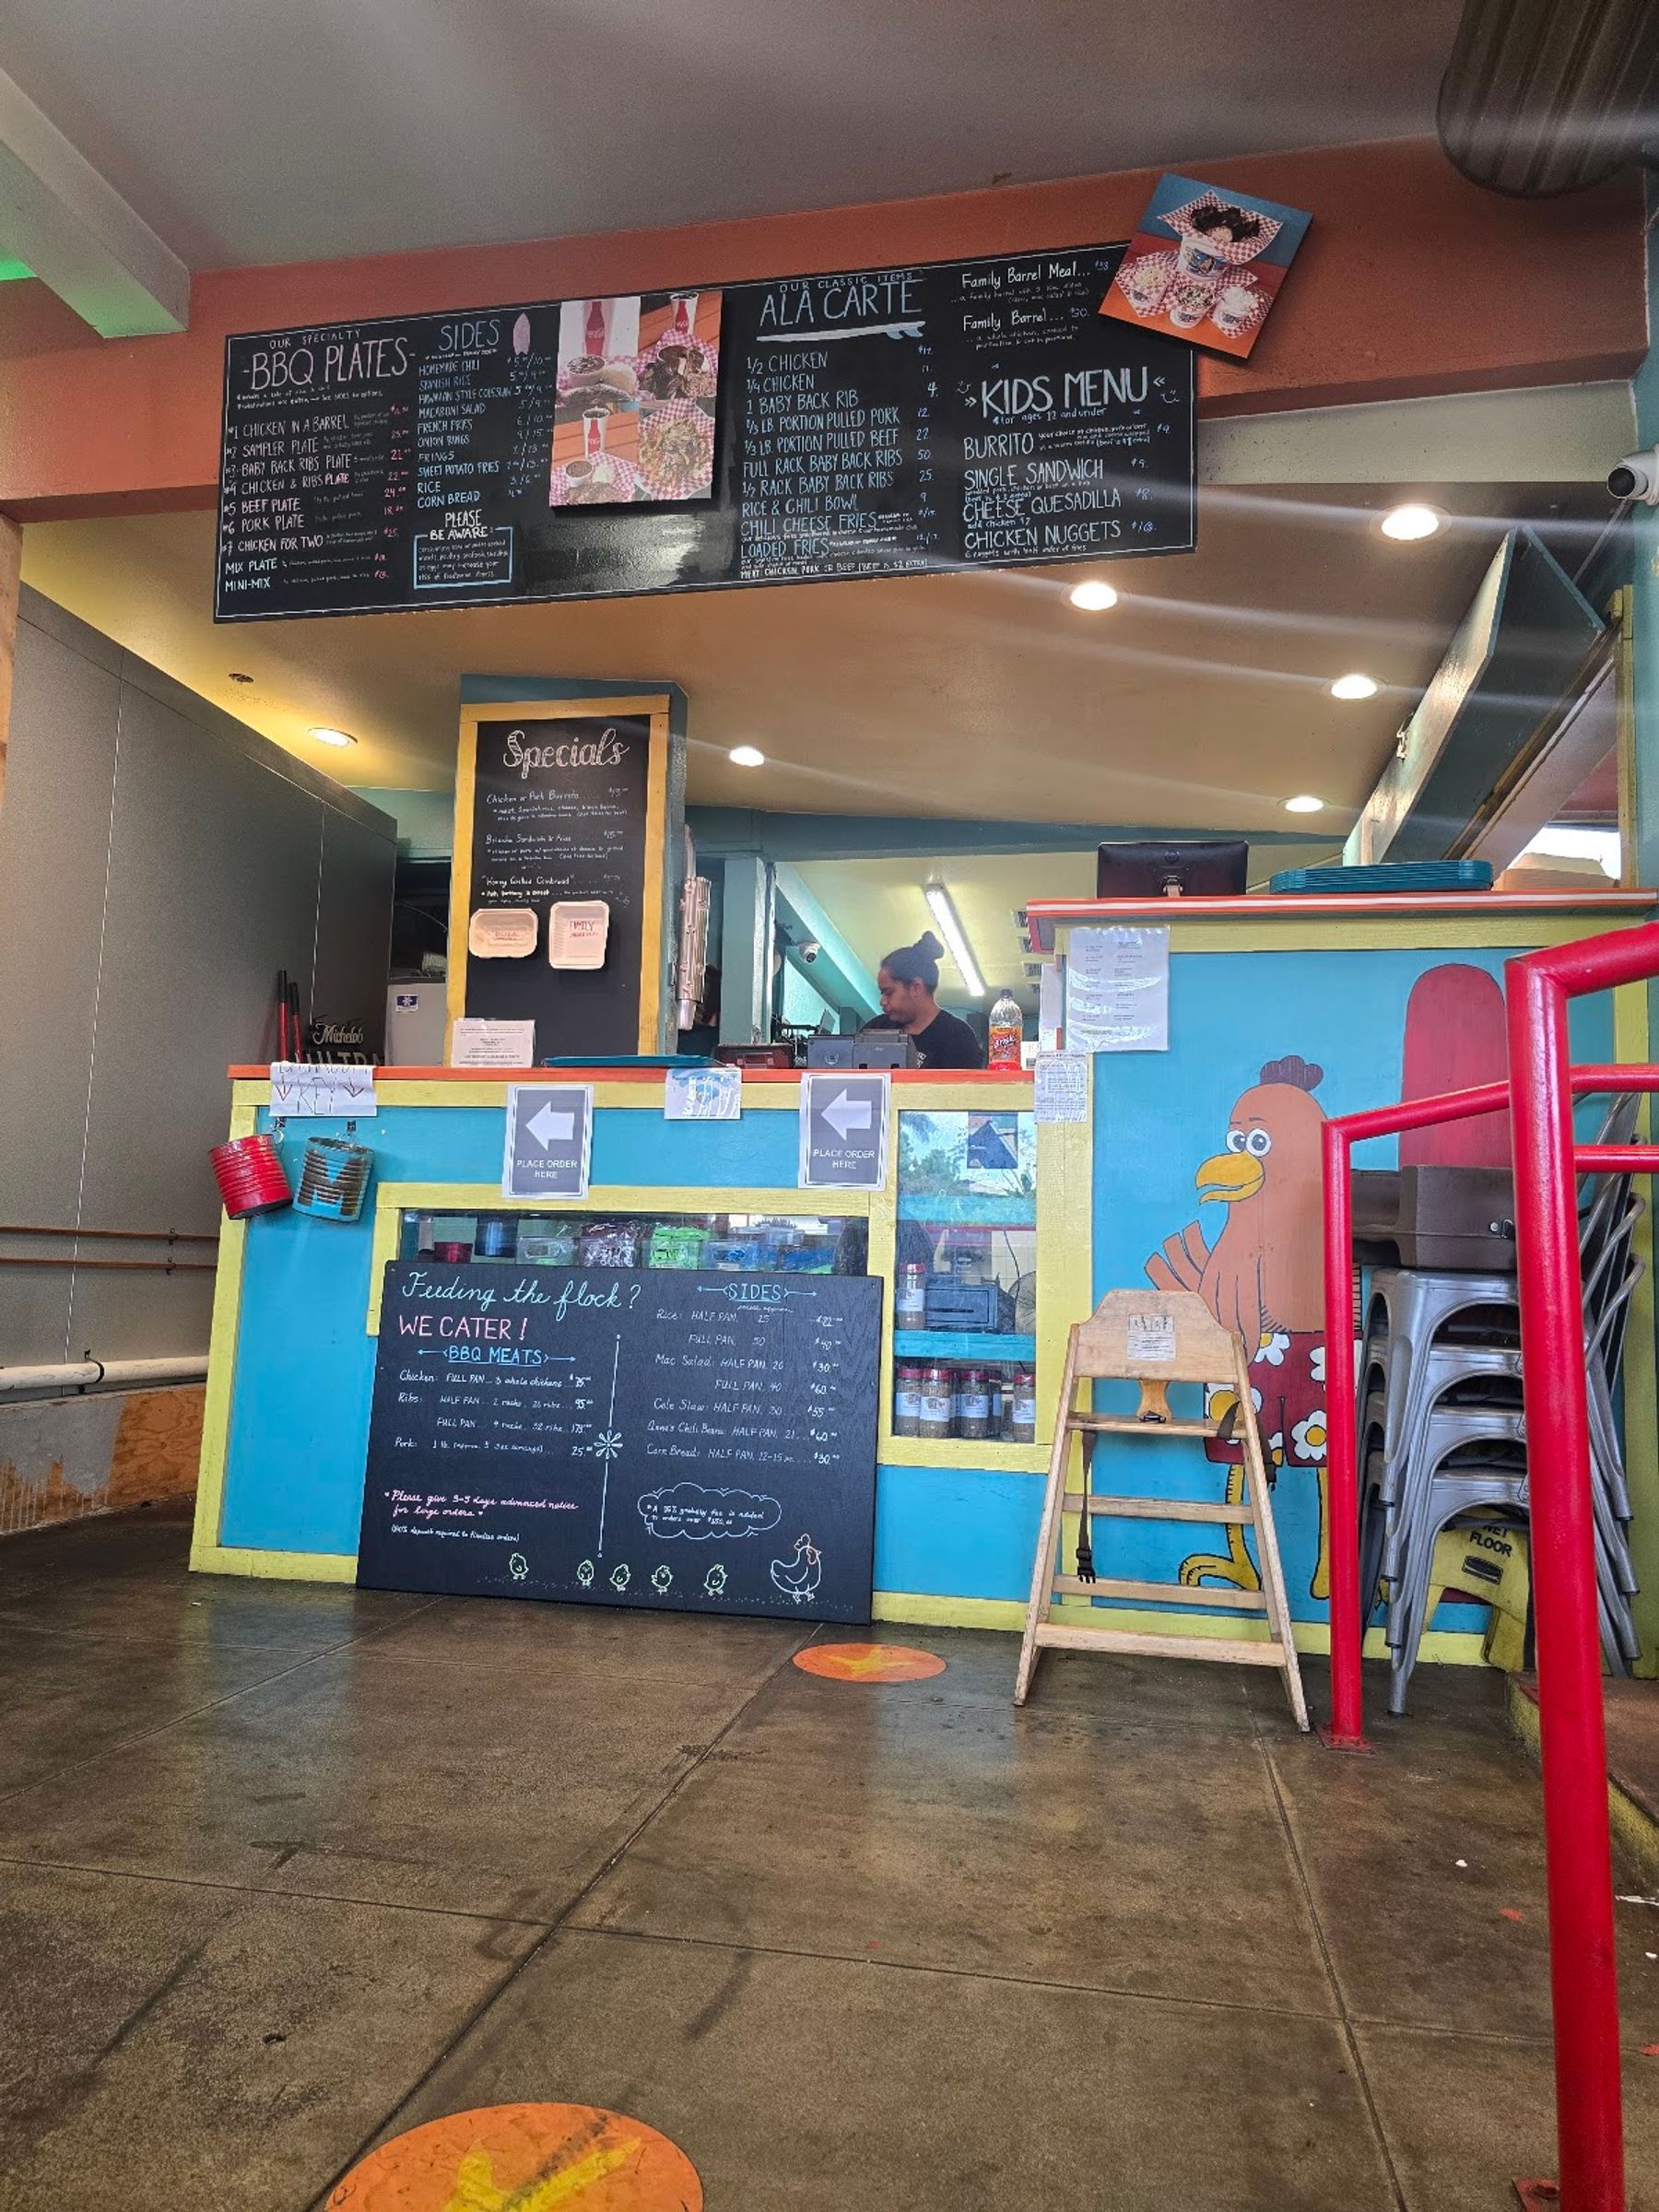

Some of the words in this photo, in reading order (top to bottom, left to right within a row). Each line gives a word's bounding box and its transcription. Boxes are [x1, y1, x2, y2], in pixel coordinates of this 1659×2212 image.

[780, 281, 810, 292] OUR
[818, 276, 867, 289] CLASSIC
[877, 272, 912, 283] ITEMS
[962, 270, 1001, 289] Family
[1007, 264, 1041, 283] Barrel
[823, 279, 924, 319] CARTE
[963, 312, 1001, 331] Family
[269, 337, 291, 349] OUR
[301, 329, 361, 346] SPECIALTY
[438, 319, 500, 351] SIDES
[769, 351, 828, 372] CHICKEN
[763, 373, 815, 393] CHICKEN
[982, 376, 1053, 418] KIDS
[1065, 367, 1147, 409] MENU
[759, 395, 792, 415] BABY
[797, 392, 830, 411] BACK
[836, 389, 859, 409] RIB
[302, 419, 310, 432] A
[312, 414, 349, 432] BARREL
[780, 414, 824, 432] PORTION
[827, 409, 865, 429] PULLED
[870, 406, 901, 427] PORK
[1021, 414, 1041, 424] ages
[1046, 411, 1057, 421] 12
[242, 441, 285, 458] SAMPLER
[291, 438, 319, 455] PLATE
[777, 434, 823, 453] PORTION
[827, 431, 865, 450] PULLED
[870, 428, 900, 448] BEEF
[964, 432, 1034, 461] BURRITO
[241, 463, 265, 477] BABY
[271, 459, 295, 475] BACK
[299, 456, 319, 472] RIBS
[326, 453, 352, 469] PLATE
[743, 461, 769, 477] FULL
[775, 456, 806, 476] RACK
[809, 453, 839, 473] BABY
[841, 451, 872, 470] BACK
[876, 449, 902, 467] RIBS
[241, 479, 285, 495] CHICKEN
[302, 475, 323, 488] RIBS
[324, 473, 349, 486] PLATE
[760, 477, 793, 497] RACK
[799, 475, 830, 495] BABY
[835, 473, 865, 491] BACK
[868, 471, 894, 488] RIBS
[964, 465, 1018, 490] SINGLE
[1026, 458, 1103, 485] SANDWICH
[418, 481, 441, 494] RICE
[241, 499, 269, 514] BEEF
[271, 498, 301, 512] PLATE
[418, 496, 444, 509] CORN
[448, 490, 480, 504] BREAD
[742, 500, 767, 518] RICE
[771, 500, 781, 517] &
[785, 498, 818, 514] CHILI
[825, 493, 859, 512] BOWL
[962, 499, 1026, 523] CHEESE
[1030, 488, 1122, 515] QUESADILLA
[241, 519, 270, 533] PORK
[276, 513, 305, 530] PLATE
[444, 509, 483, 528] PLEASE
[741, 517, 776, 536] CHILI
[783, 515, 832, 535] CHEESE
[839, 512, 877, 529] FRIES
[238, 540, 276, 552] CHICKEN
[280, 537, 299, 550] FOR
[300, 535, 323, 548] TWO
[429, 529, 444, 540] BE
[964, 525, 1038, 550] CHICKEN
[1045, 520, 1122, 545] NUGGETS
[741, 541, 786, 559] LOADED
[794, 537, 830, 556] FRIES
[225, 562, 243, 575] MIX
[249, 558, 277, 571] PLATE
[225, 577, 271, 593] MINI-MIX
[503, 728, 630, 780] Specials
[312, 1023, 363, 1045] Michelob
[297, 1077, 337, 1115] KEY
[813, 1148, 843, 1158] PLACE
[844, 1149, 876, 1159] ORDER
[517, 1159, 545, 1169] PLACE
[547, 1159, 578, 1169] ORDER
[832, 1160, 857, 1170] HERE
[535, 1171, 559, 1179] HERE
[402, 1272, 497, 1312] Feeding
[503, 1278, 551, 1304] the
[728, 1283, 782, 1301] SIDES
[399, 1314, 433, 1336] WE
[691, 1311, 714, 1322] HALF
[688, 1334, 710, 1345] FULL
[449, 1347, 481, 1361] BBQ
[488, 1347, 543, 1365] MEATS
[655, 1354, 676, 1365] Mac
[720, 1359, 747, 1370] HALF
[446, 1372, 467, 1382] FULL
[714, 1379, 739, 1391] FULL
[653, 1398, 675, 1410] Cole
[713, 1403, 739, 1414] HALF
[731, 1426, 756, 1437] HALF
[708, 1448, 733, 1459] HALF
[391, 1489, 422, 1501] Please
[427, 1494, 447, 1506] give
[473, 1496, 497, 1510] days
[393, 1503, 409, 1517] for
[414, 1506, 440, 1519] large
[1469, 1531, 1512, 1558] FLOOR
